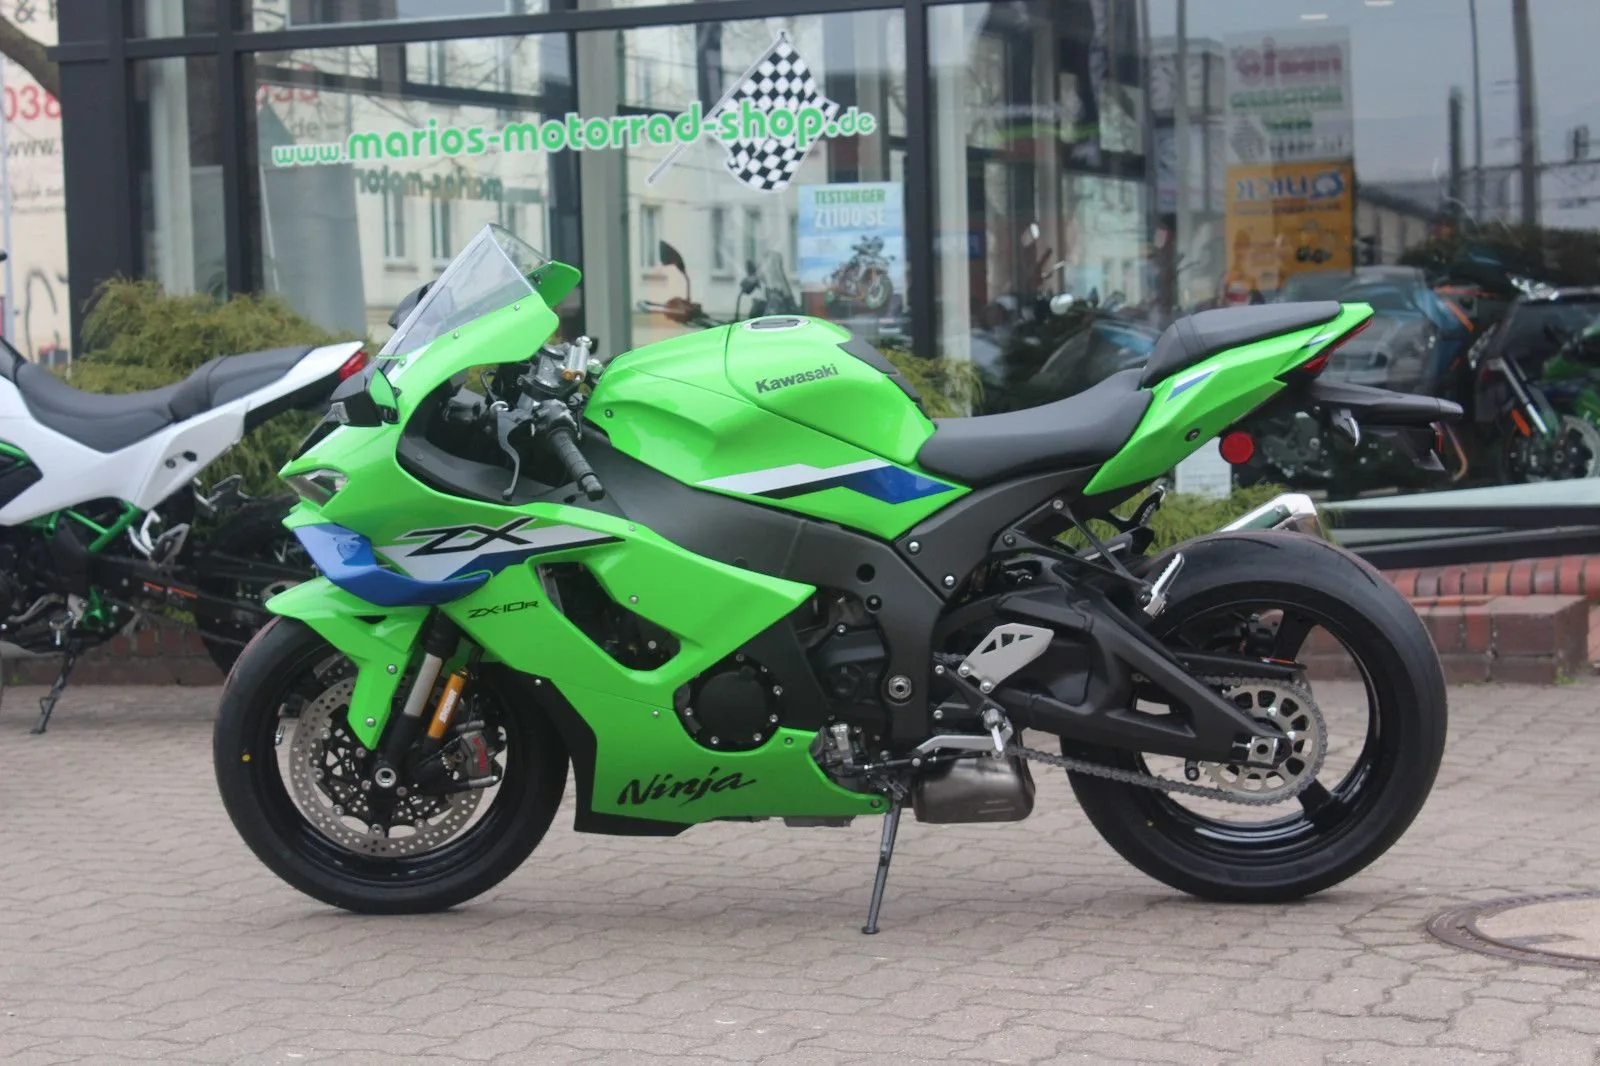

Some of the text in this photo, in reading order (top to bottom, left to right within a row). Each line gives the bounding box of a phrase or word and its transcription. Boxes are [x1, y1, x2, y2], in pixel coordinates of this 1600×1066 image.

[814, 188, 887, 205] TESTSIEGER
[755, 363, 839, 394] Kawasaki
[400, 516, 536, 558] ZX
[467, 601, 539, 619] ZX-10R
[616, 766, 757, 807] Ninja
